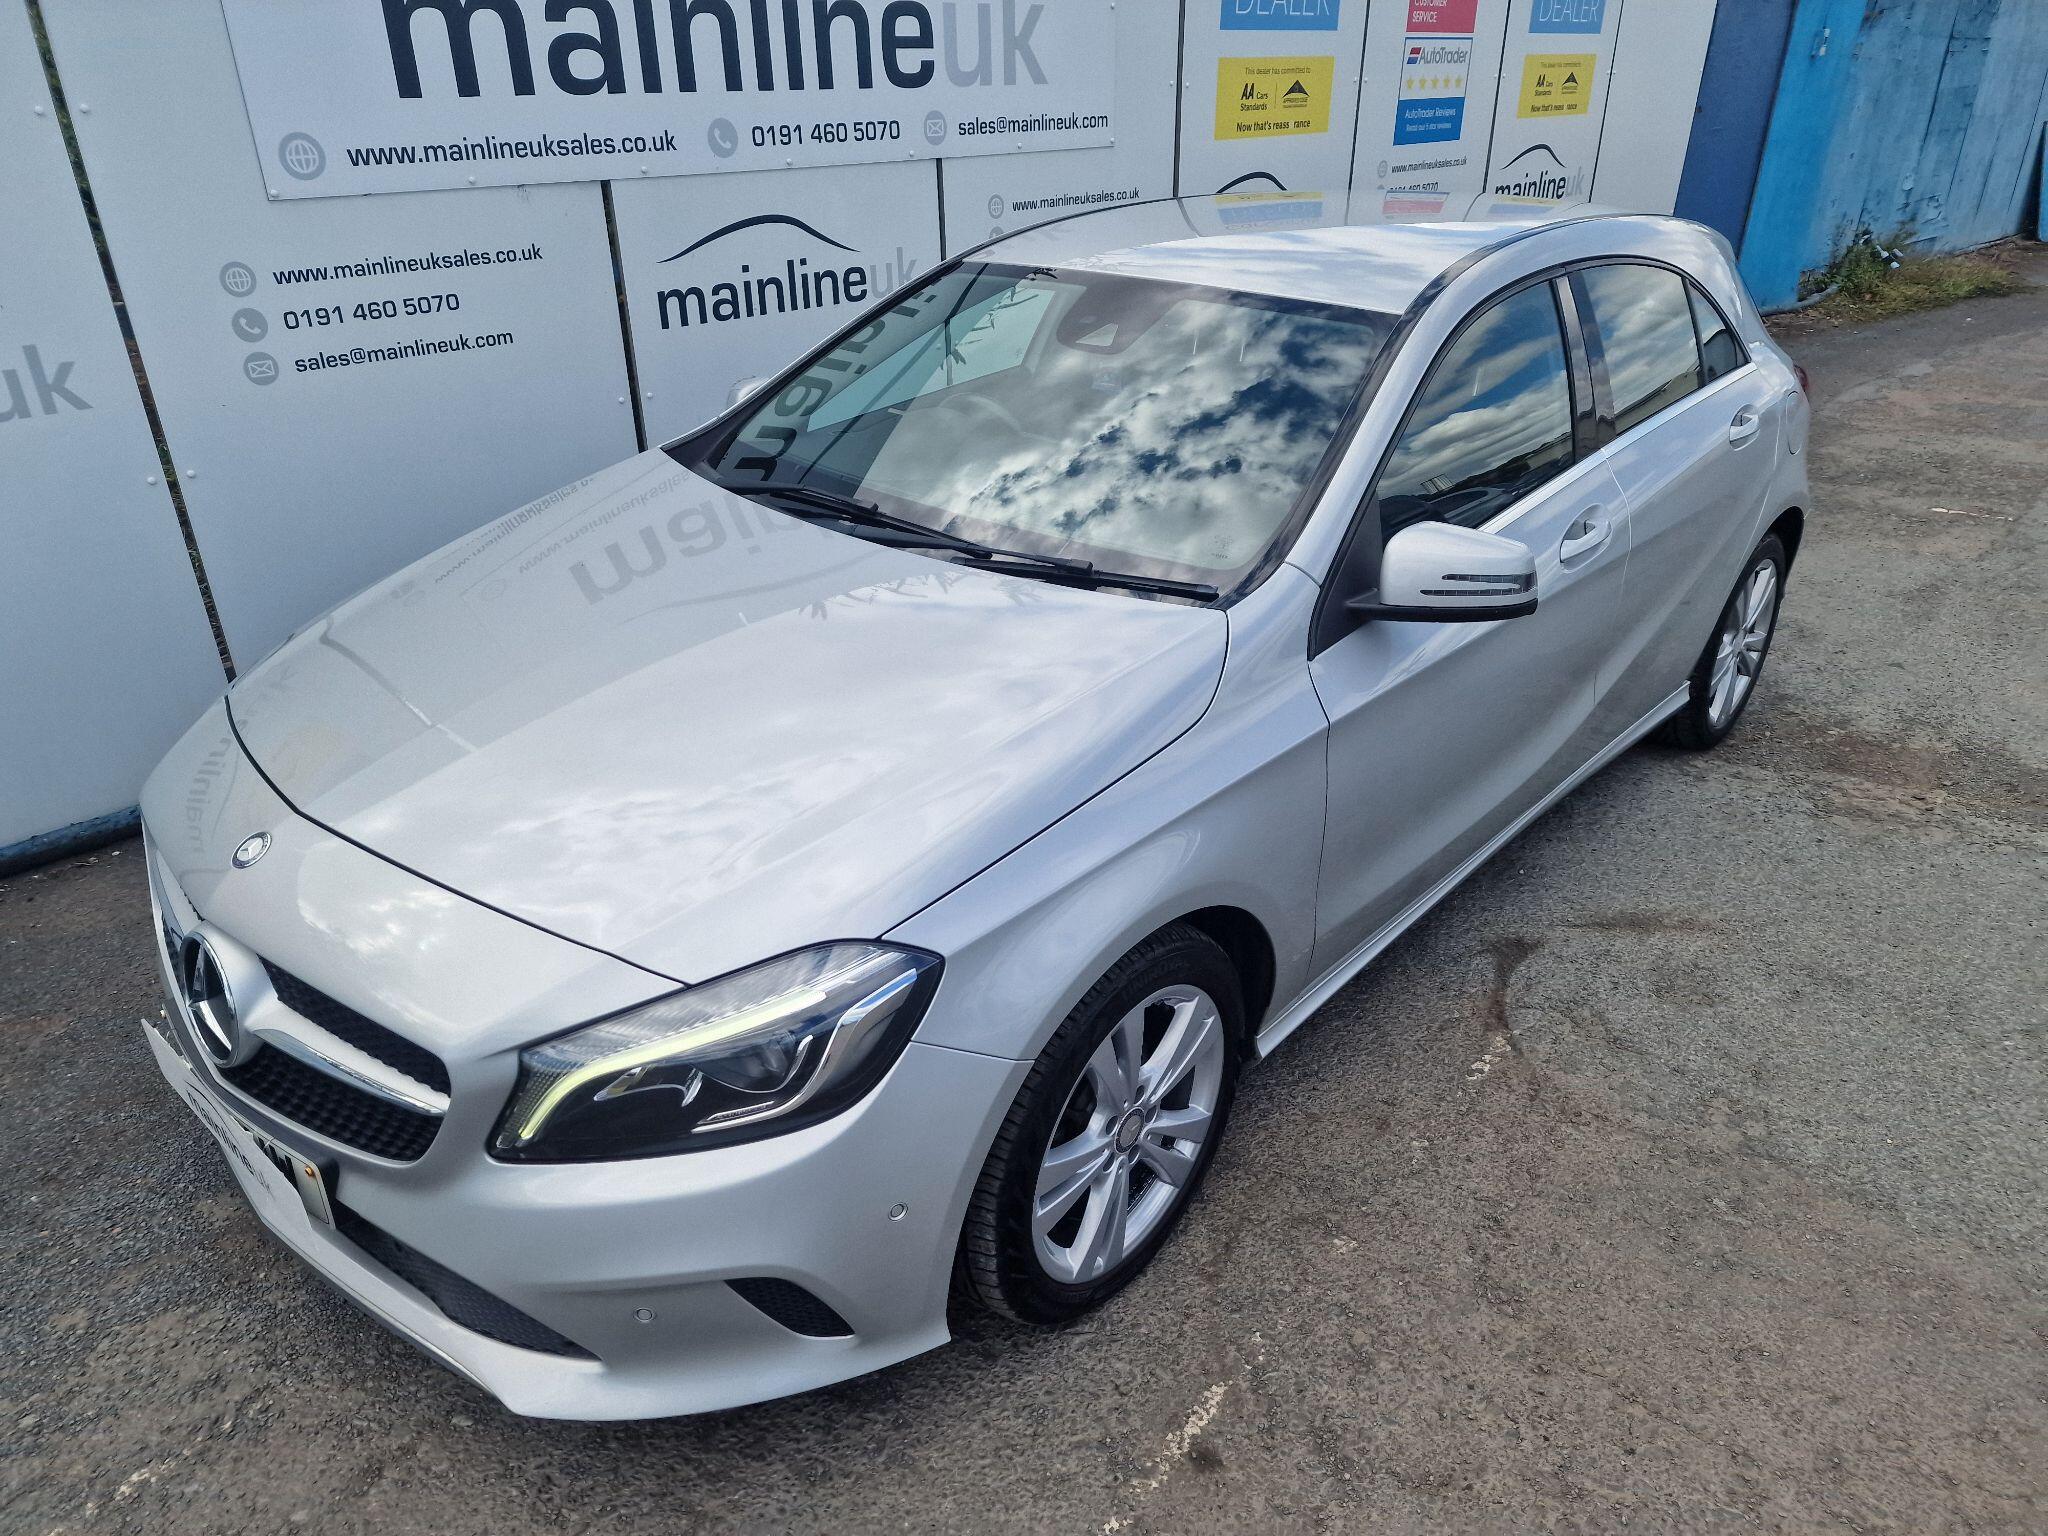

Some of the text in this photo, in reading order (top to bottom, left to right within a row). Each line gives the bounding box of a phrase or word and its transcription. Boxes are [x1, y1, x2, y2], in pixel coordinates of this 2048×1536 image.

[1412, 11, 1438, 22] SERVICE
[1539, 0, 1600, 21] DEALER
[1418, 47, 1468, 64] AutoTrader
[1241, 83, 1268, 100] AA Cars
[1240, 103, 1267, 111] Standards
[752, 120, 900, 147] 0191 460 5070
[958, 112, 1108, 136] sales@mainlineuk.com
[1236, 122, 1252, 132] Now
[1253, 121, 1272, 131] that's
[347, 130, 677, 167] www.mainlineuksales.co.uk
[1391, 156, 1467, 173] www.mainlineuksales.co.uk
[1012, 187, 1140, 211] www.mainlineuksales.co.uk
[273, 243, 543, 285] www.mainlineuksales.co.uk
[657, 247, 917, 329] mainlineuk
[283, 293, 460, 330] 0191 460 5070
[294, 331, 514, 372] sales@mainlineuk.com
